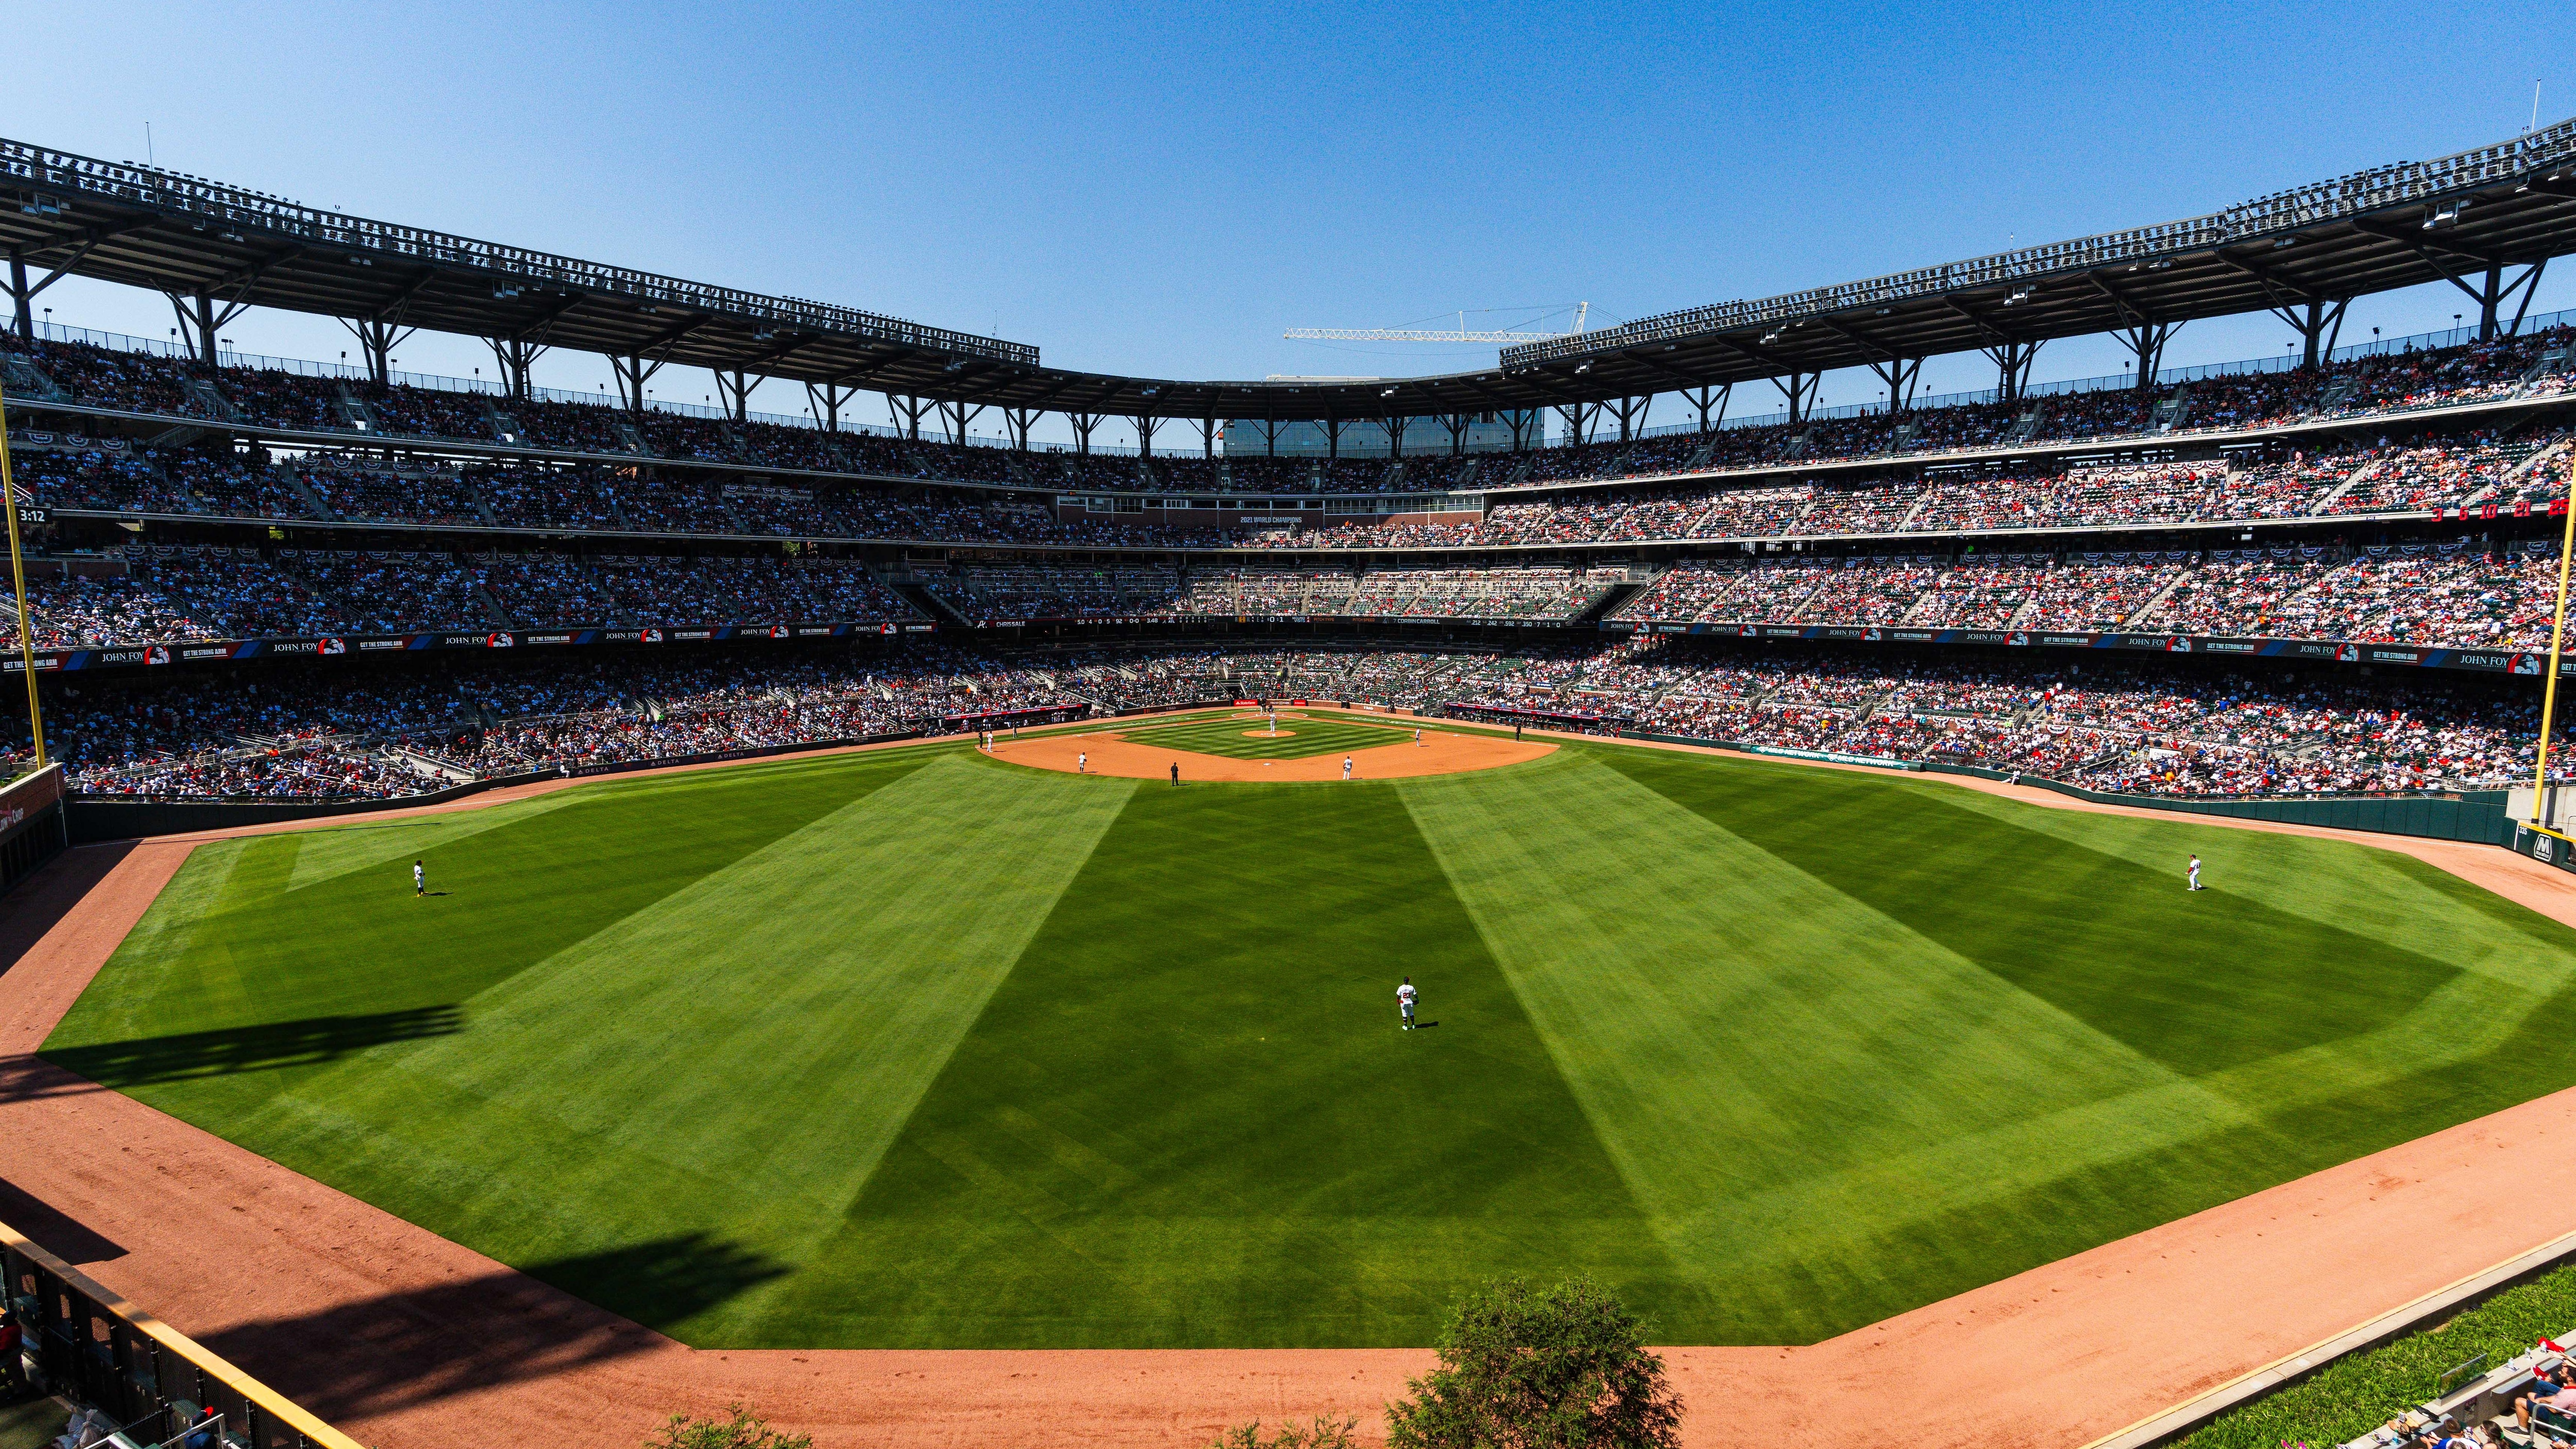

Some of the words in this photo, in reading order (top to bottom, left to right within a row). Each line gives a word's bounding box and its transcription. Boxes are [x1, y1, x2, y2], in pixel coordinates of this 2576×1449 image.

[2459, 506, 2469, 520] 6
[2480, 504, 2498, 519] 10
[2514, 501, 2531, 517] 21
[2548, 499, 2569, 516] 25
[20, 510, 45, 521] 3:12
[2432, 508, 2443, 521] 3
[103, 652, 126, 662] JOHN
[129, 652, 144, 660] FOY
[2461, 655, 2487, 664] JOHN
[2490, 656, 2509, 665] FOY
[1785, 748, 1820, 759] NETWORK
[1855, 756, 1894, 767] NETWORK
[12, 807, 24, 823] CHOP
[2519, 826, 2527, 835] 335
[2536, 837, 2550, 854] M
